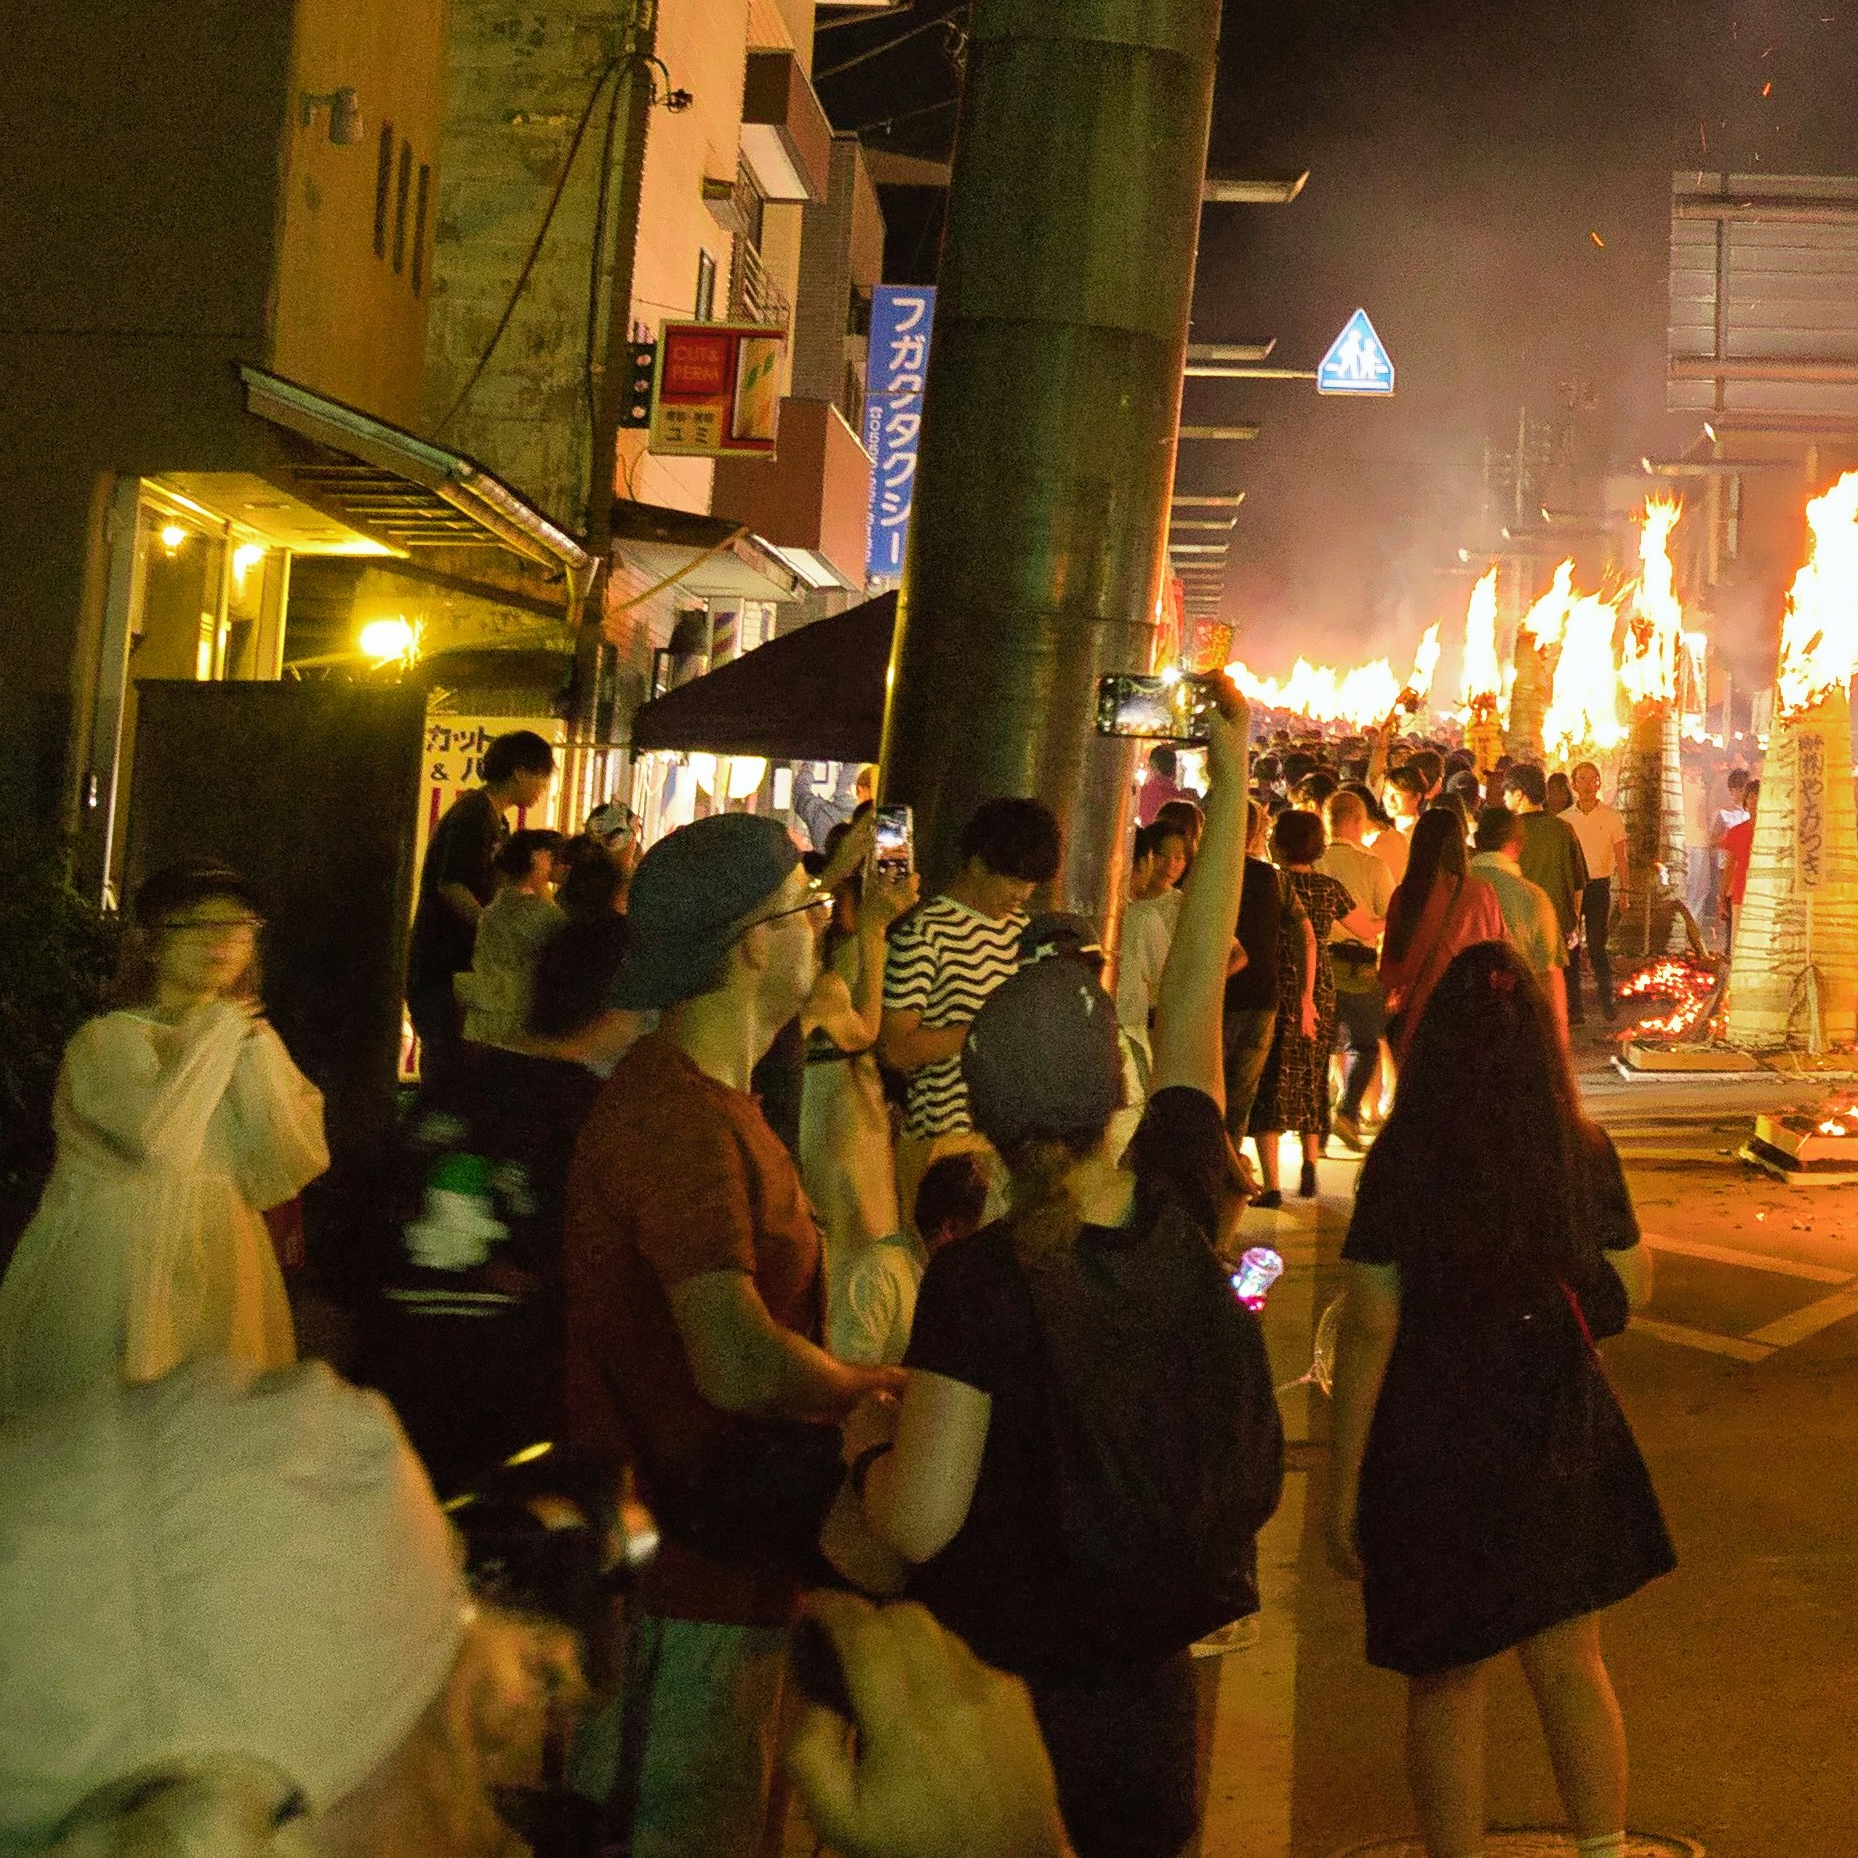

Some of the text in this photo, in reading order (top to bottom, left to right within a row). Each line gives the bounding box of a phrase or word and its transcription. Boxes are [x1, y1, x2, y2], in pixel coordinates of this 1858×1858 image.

[880, 297, 925, 564] フガクタクシー
